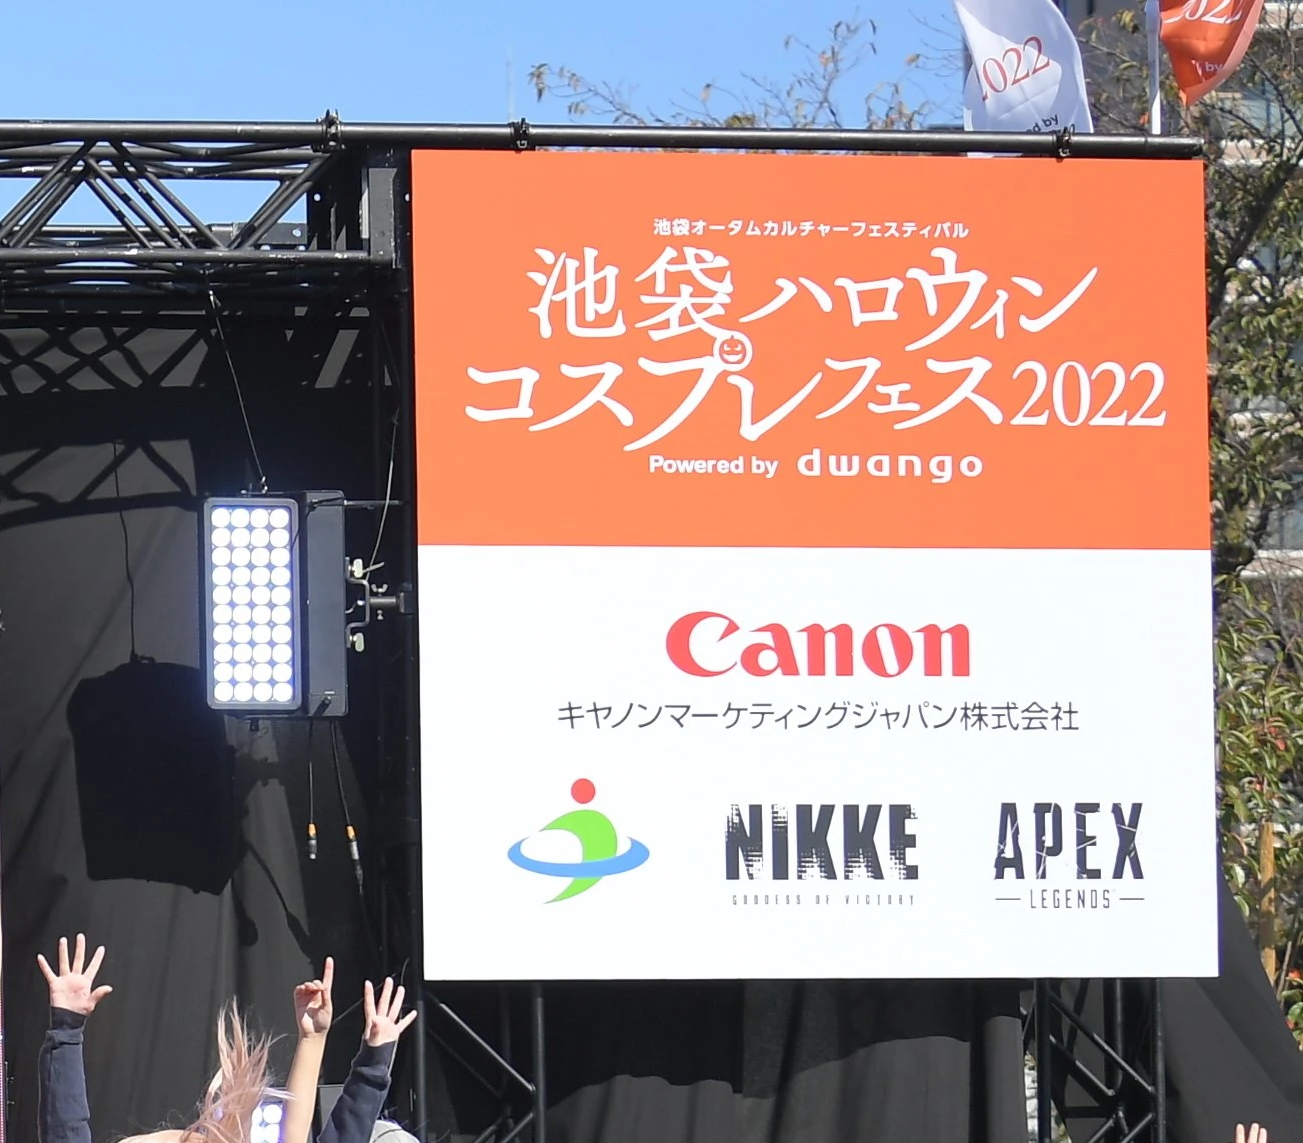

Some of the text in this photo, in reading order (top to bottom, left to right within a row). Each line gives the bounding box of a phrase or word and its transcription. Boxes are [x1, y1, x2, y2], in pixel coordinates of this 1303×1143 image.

[981, 35, 1051, 102] 022
[653, 217, 970, 240] 池袋オータムカルチャーフェスティバル
[525, 246, 1099, 351] 池袋ハロウィン
[463, 340, 1167, 453] コスプレフェス2022
[648, 447, 985, 485] Powered by dwango
[665, 610, 970, 679] Canon
[557, 701, 1080, 732] キヤノンマーケティングジャパン株式会社
[725, 803, 919, 881] NIKKE
[993, 801, 1145, 881] APEX
[732, 894, 914, 906] GODDESS OF VICTORY
[1029, 888, 1111, 909] LEGENDS
